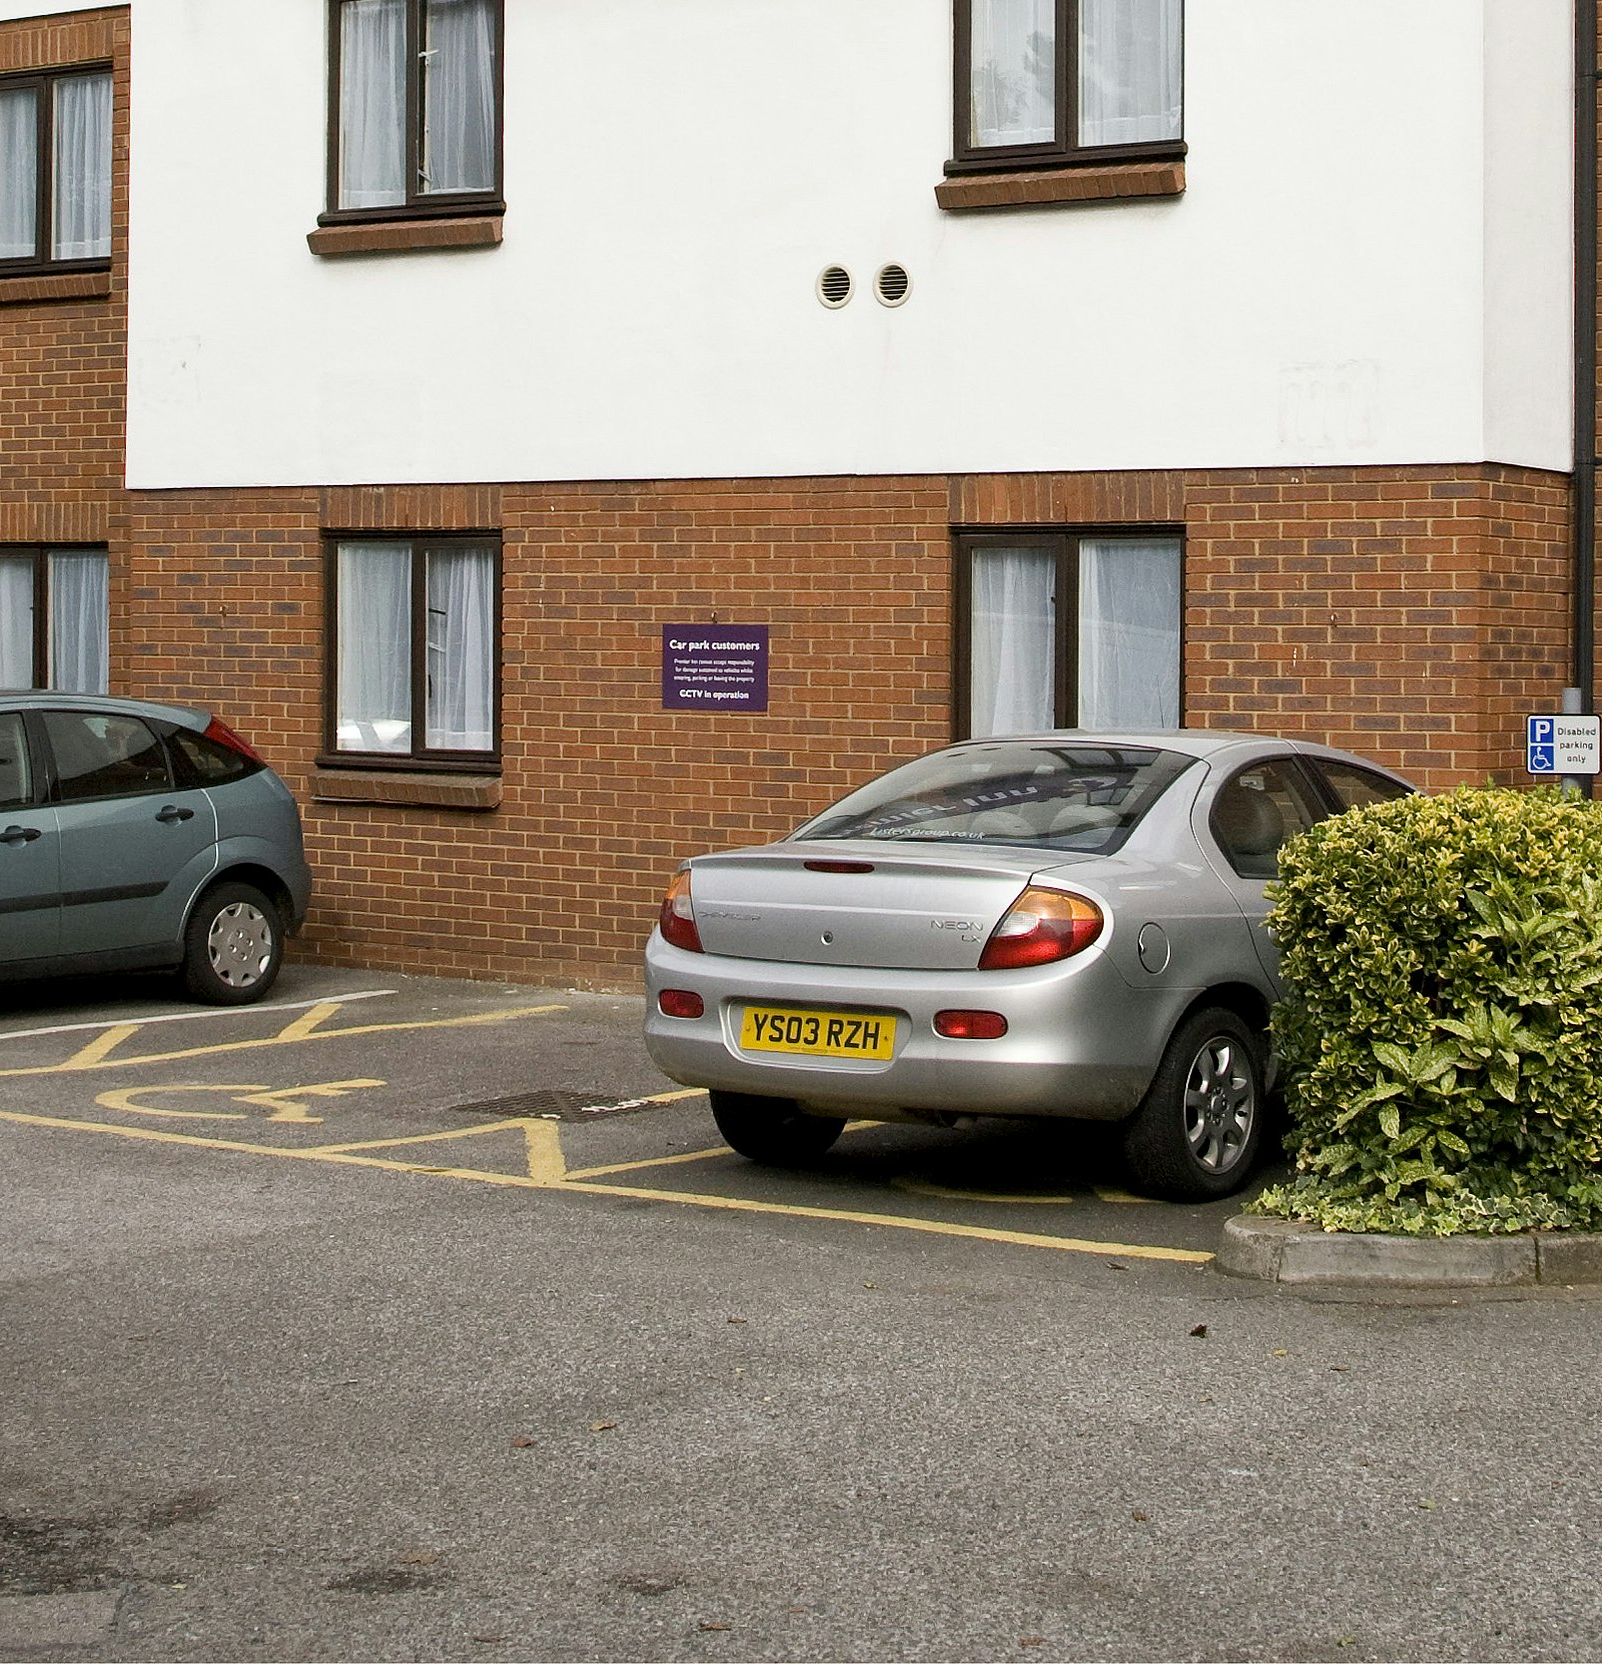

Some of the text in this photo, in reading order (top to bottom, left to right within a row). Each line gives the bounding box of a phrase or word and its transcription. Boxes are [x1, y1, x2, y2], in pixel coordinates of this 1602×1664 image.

[669, 639, 760, 652] Car park customers
[679, 689, 750, 701] CCTV in operation
[1535, 720, 1550, 742] P
[1557, 727, 1596, 736] Disabled
[1559, 742, 1593, 751] parking
[1567, 755, 1586, 763] only
[930, 920, 983, 932] NEON
[961, 934, 982, 944] LX
[753, 1013, 881, 1050] YS03 RZH
